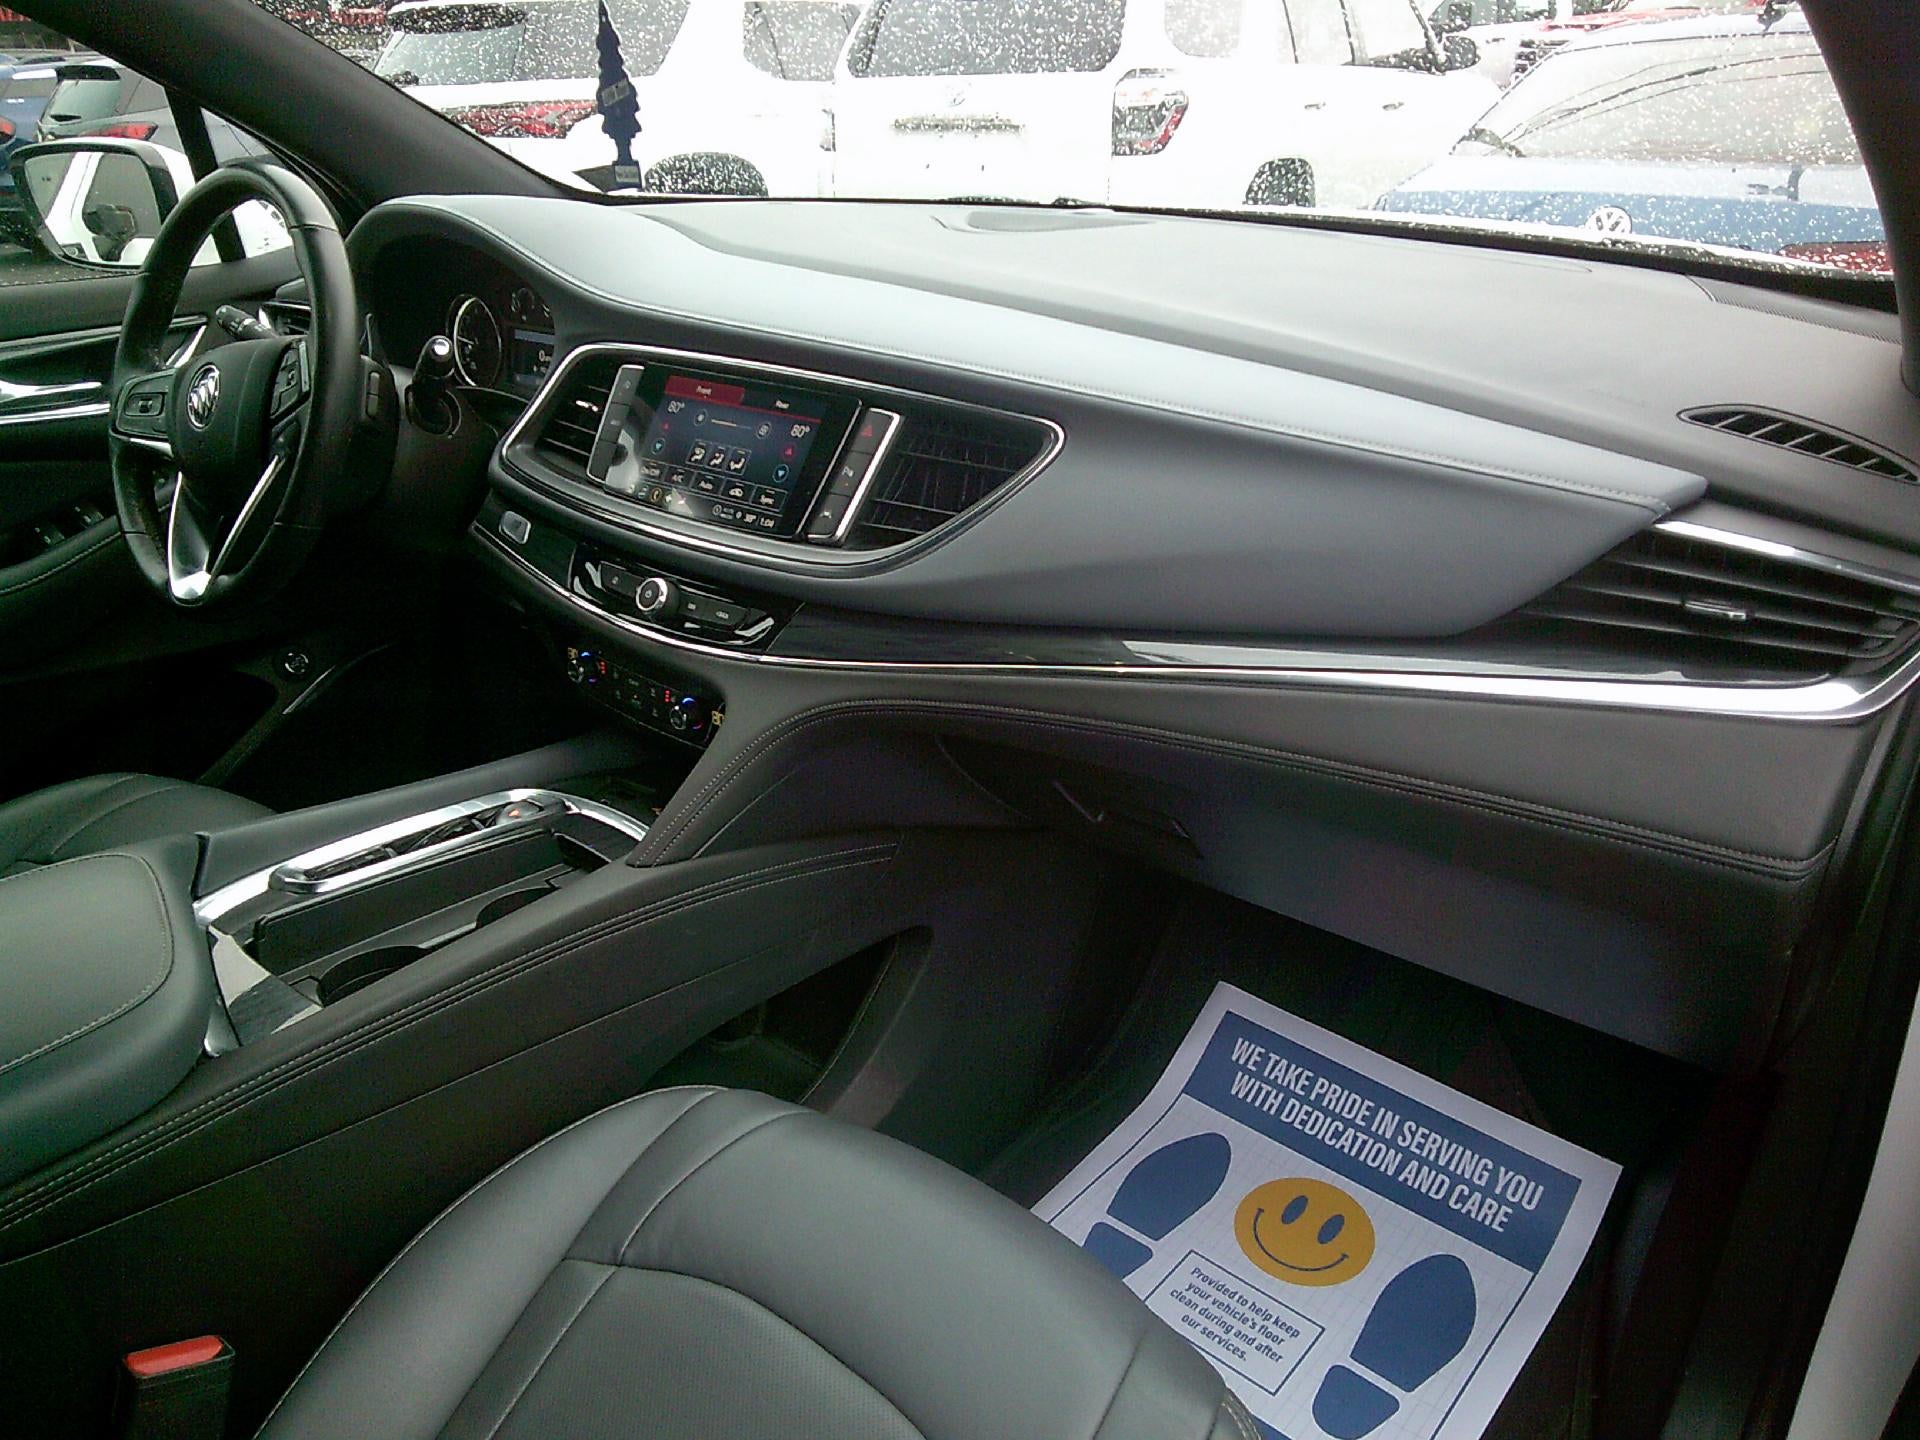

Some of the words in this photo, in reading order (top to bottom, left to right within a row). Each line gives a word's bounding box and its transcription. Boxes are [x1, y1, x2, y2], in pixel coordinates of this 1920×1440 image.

[1230, 1071, 1284, 1115] WITH
[1280, 1098, 1403, 1176] DEDICATION
[1398, 1160, 1450, 1200] AND
[1448, 1184, 1513, 1232] CARE
[1231, 1037, 1265, 1071] WE
[1263, 1052, 1314, 1096] TAKE
[1309, 1077, 1375, 1126] PRIDE
[1371, 1107, 1400, 1139] IN
[1397, 1121, 1494, 1187] SERVING
[1494, 1166, 1544, 1210] YOU
[1170, 1288, 1199, 1311] clean
[1198, 1306, 1235, 1334] during
[1233, 1329, 1257, 1346] and
[1254, 1342, 1284, 1362] after
[1181, 1313, 1201, 1329] our
[1200, 1325, 1247, 1361] services.
[1185, 1283, 1212, 1301] your
[1211, 1297, 1258, 1330] vehicle's
[1258, 1323, 1285, 1346] floor
[1191, 1267, 1239, 1299] Provided
[1236, 1295, 1248, 1306] to
[1248, 1302, 1273, 1322] help
[1272, 1315, 1300, 1338] keep
